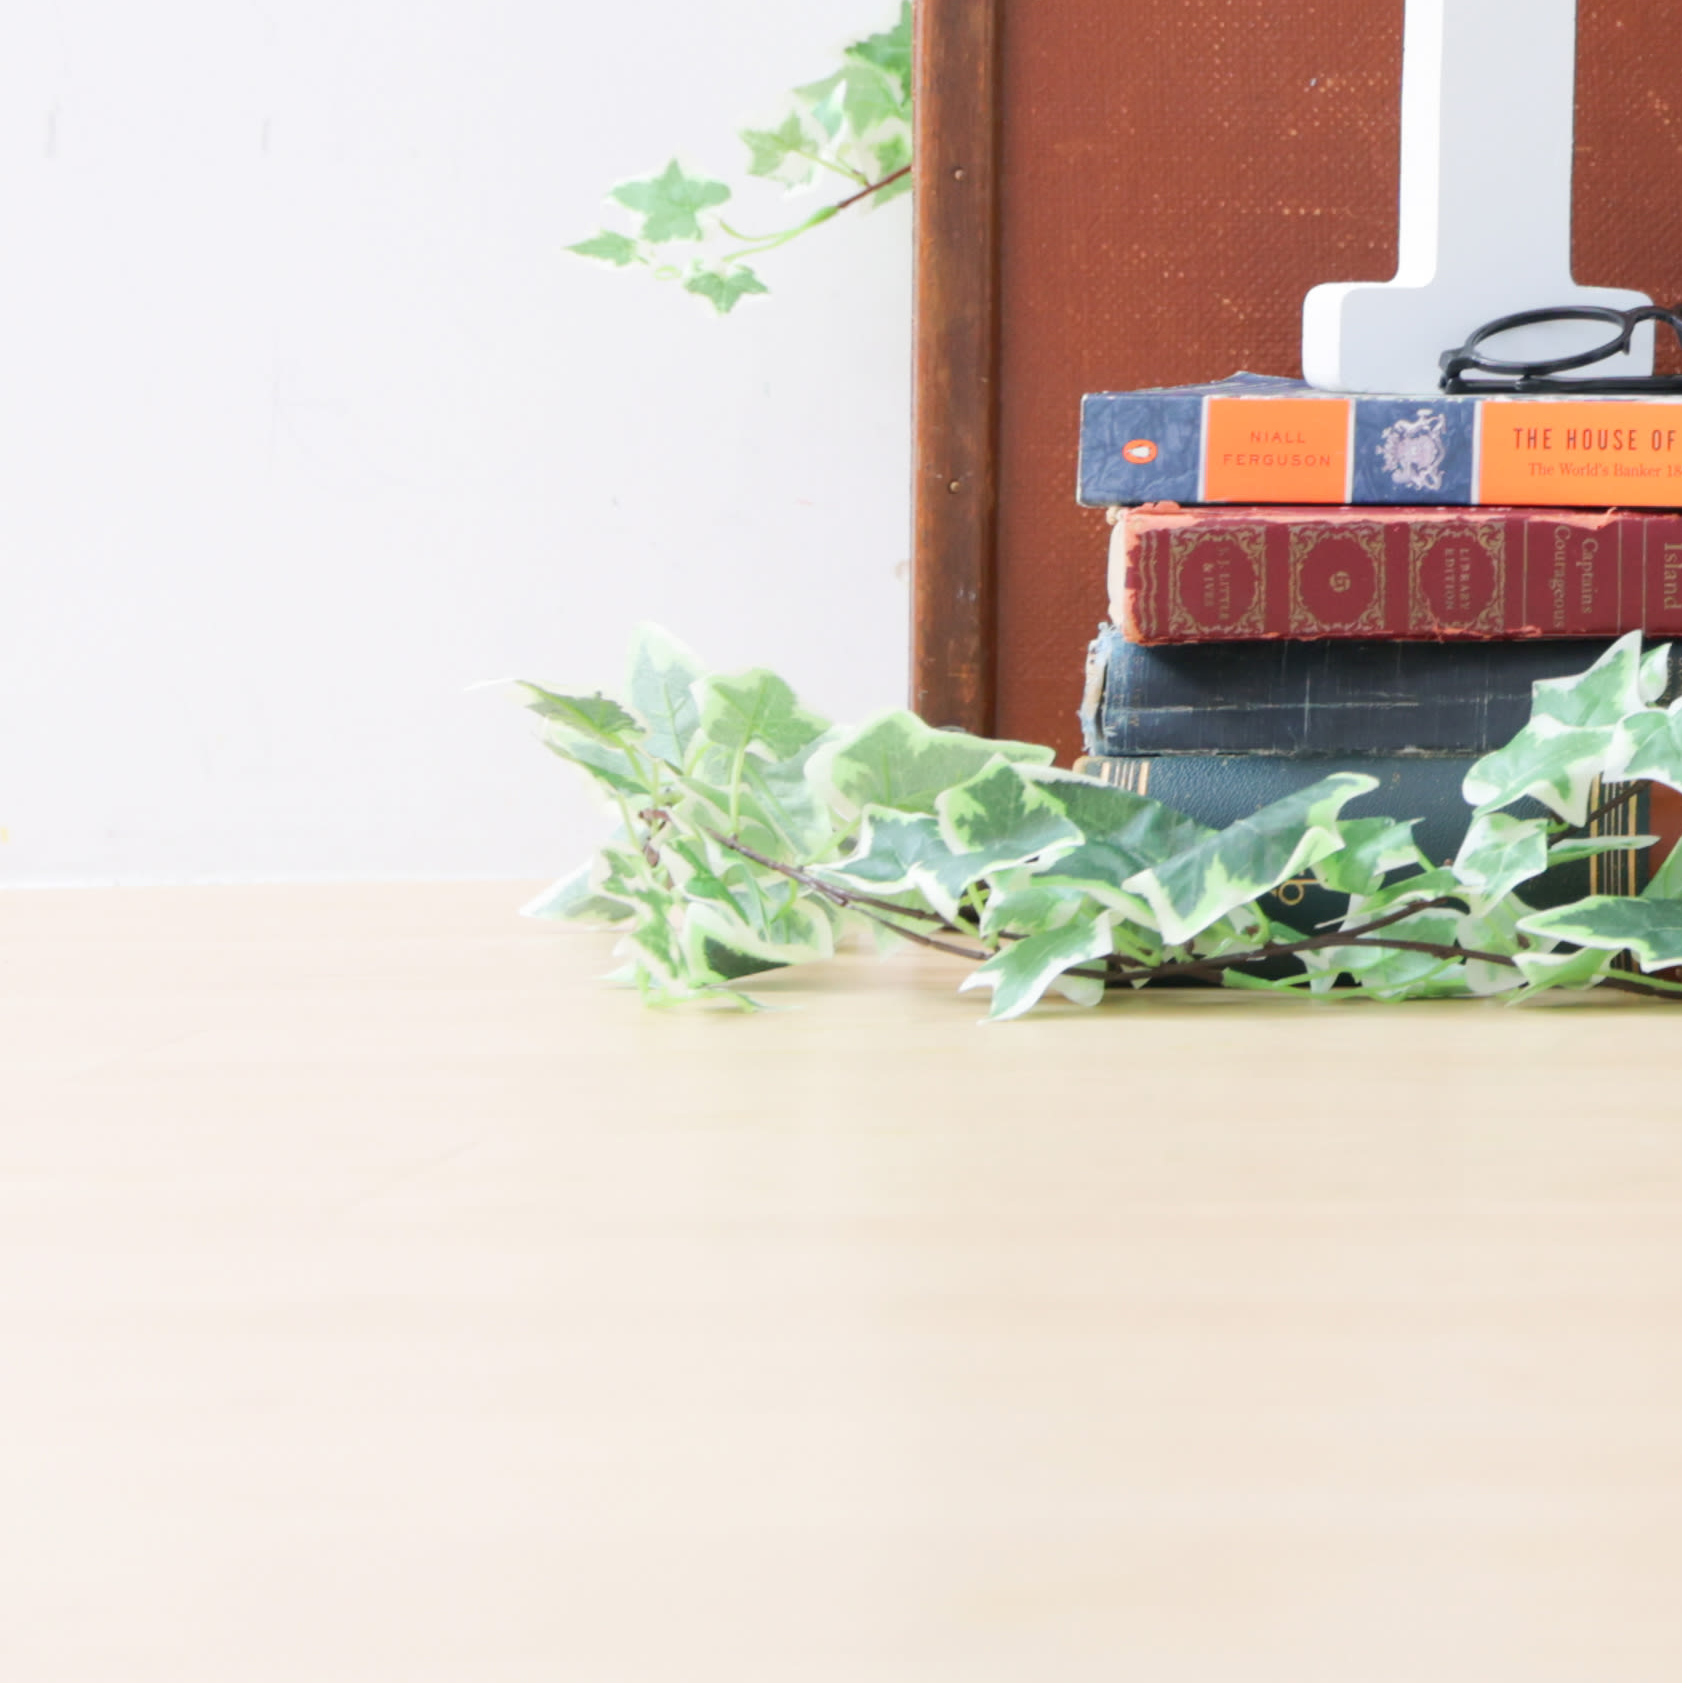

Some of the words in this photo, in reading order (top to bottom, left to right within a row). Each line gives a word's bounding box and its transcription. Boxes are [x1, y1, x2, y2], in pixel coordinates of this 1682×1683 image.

[1250, 430, 1306, 444] NIALL
[1513, 428, 1552, 450] THE
[1566, 429, 1637, 451] HOUSE
[1651, 429, 1677, 452] OF
[1223, 453, 1331, 467] FERGUSON
[1528, 462, 1554, 477] The
[1558, 462, 1609, 478] World's
[1613, 462, 1662, 478] Banker
[1445, 548, 1456, 610] EDITION
[1460, 548, 1470, 610] LIBRARY
[1550, 525, 1571, 629] Courageous
[1576, 538, 1598, 614] Captains
